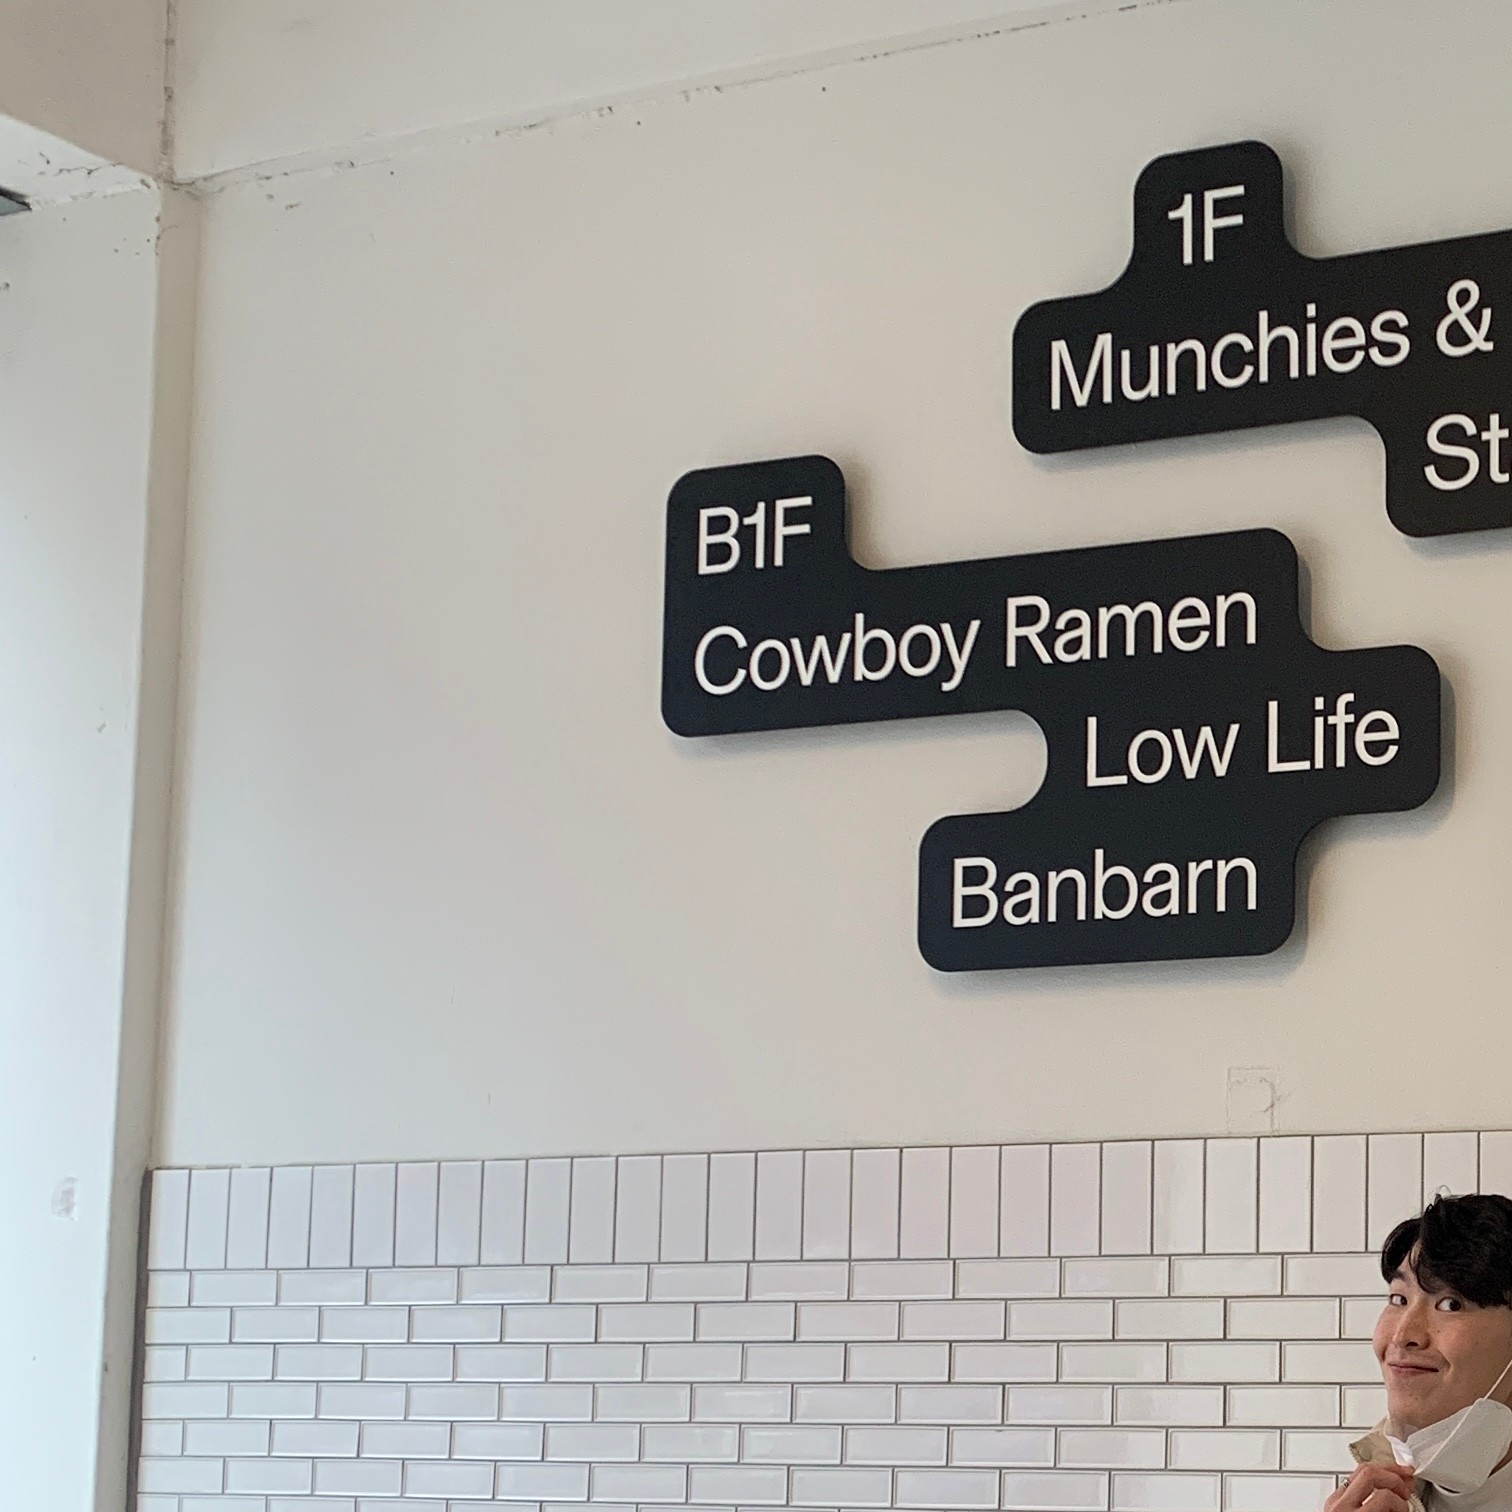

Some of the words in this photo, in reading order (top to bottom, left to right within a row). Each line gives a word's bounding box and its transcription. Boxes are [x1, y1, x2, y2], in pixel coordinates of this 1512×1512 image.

[1166, 183, 1246, 266] 1F
[1050, 302, 1412, 411] Munchies
[1435, 278, 1495, 358] &
[695, 496, 814, 577] B1F
[693, 611, 982, 697] Cowboy
[1005, 590, 1258, 668] Ramen
[1085, 715, 1241, 788] Low
[1266, 691, 1401, 774] Life
[951, 847, 1258, 929] Banbarn
